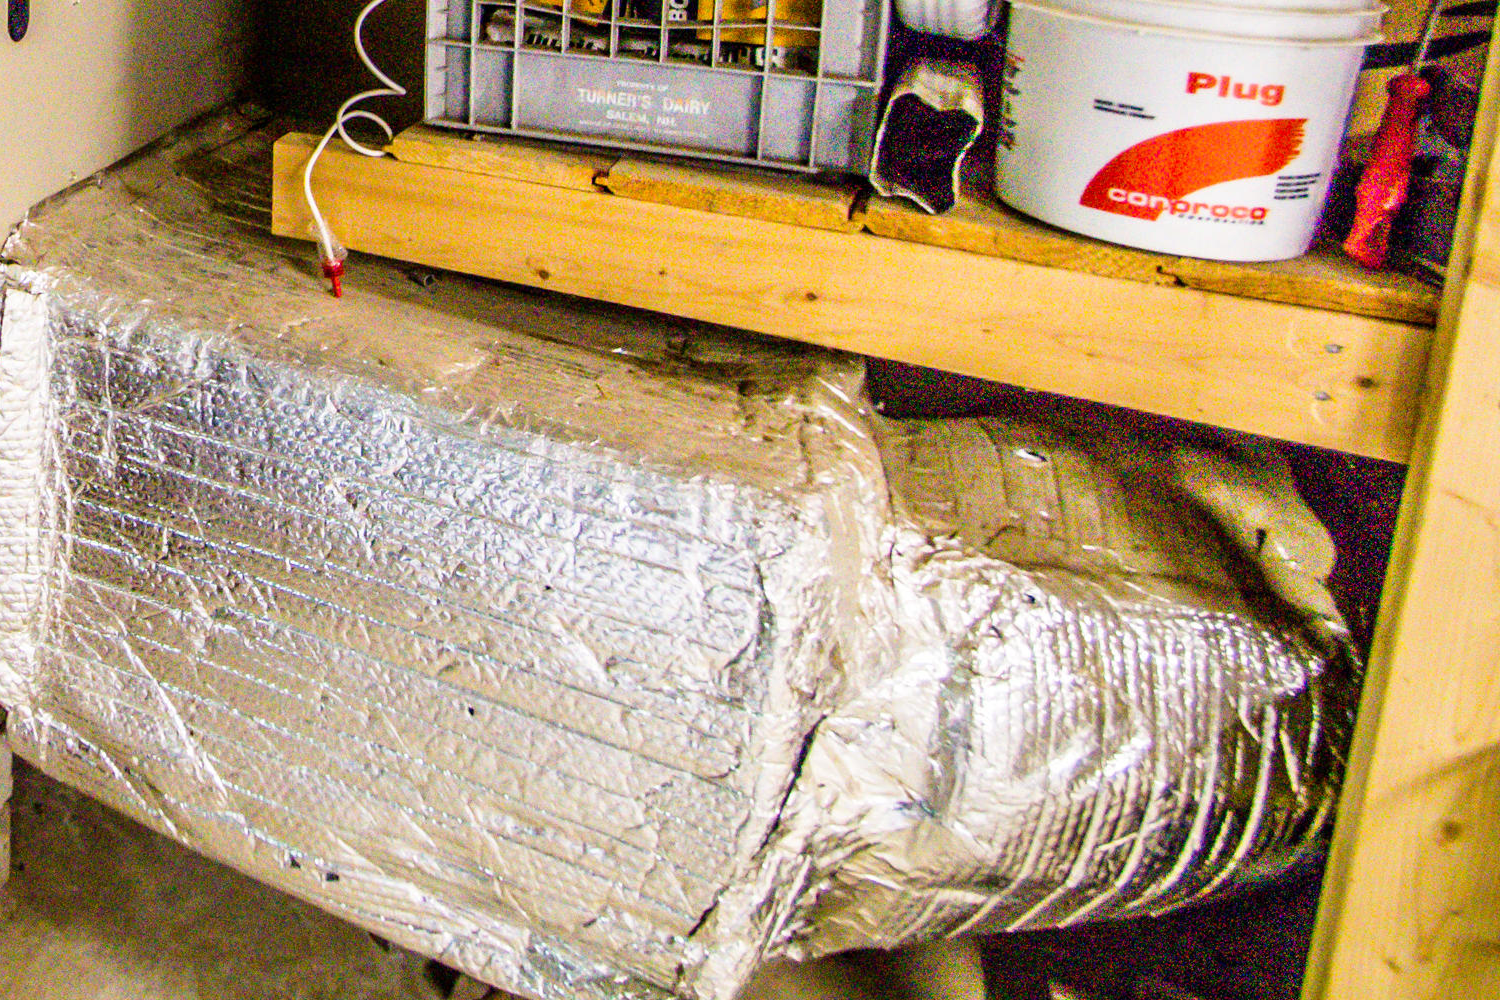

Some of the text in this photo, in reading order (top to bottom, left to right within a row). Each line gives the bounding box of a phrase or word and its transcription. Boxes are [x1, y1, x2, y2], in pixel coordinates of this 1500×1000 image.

[577, 87, 711, 115] TURNER'S DAIRY
[1185, 71, 1286, 107] Plug
